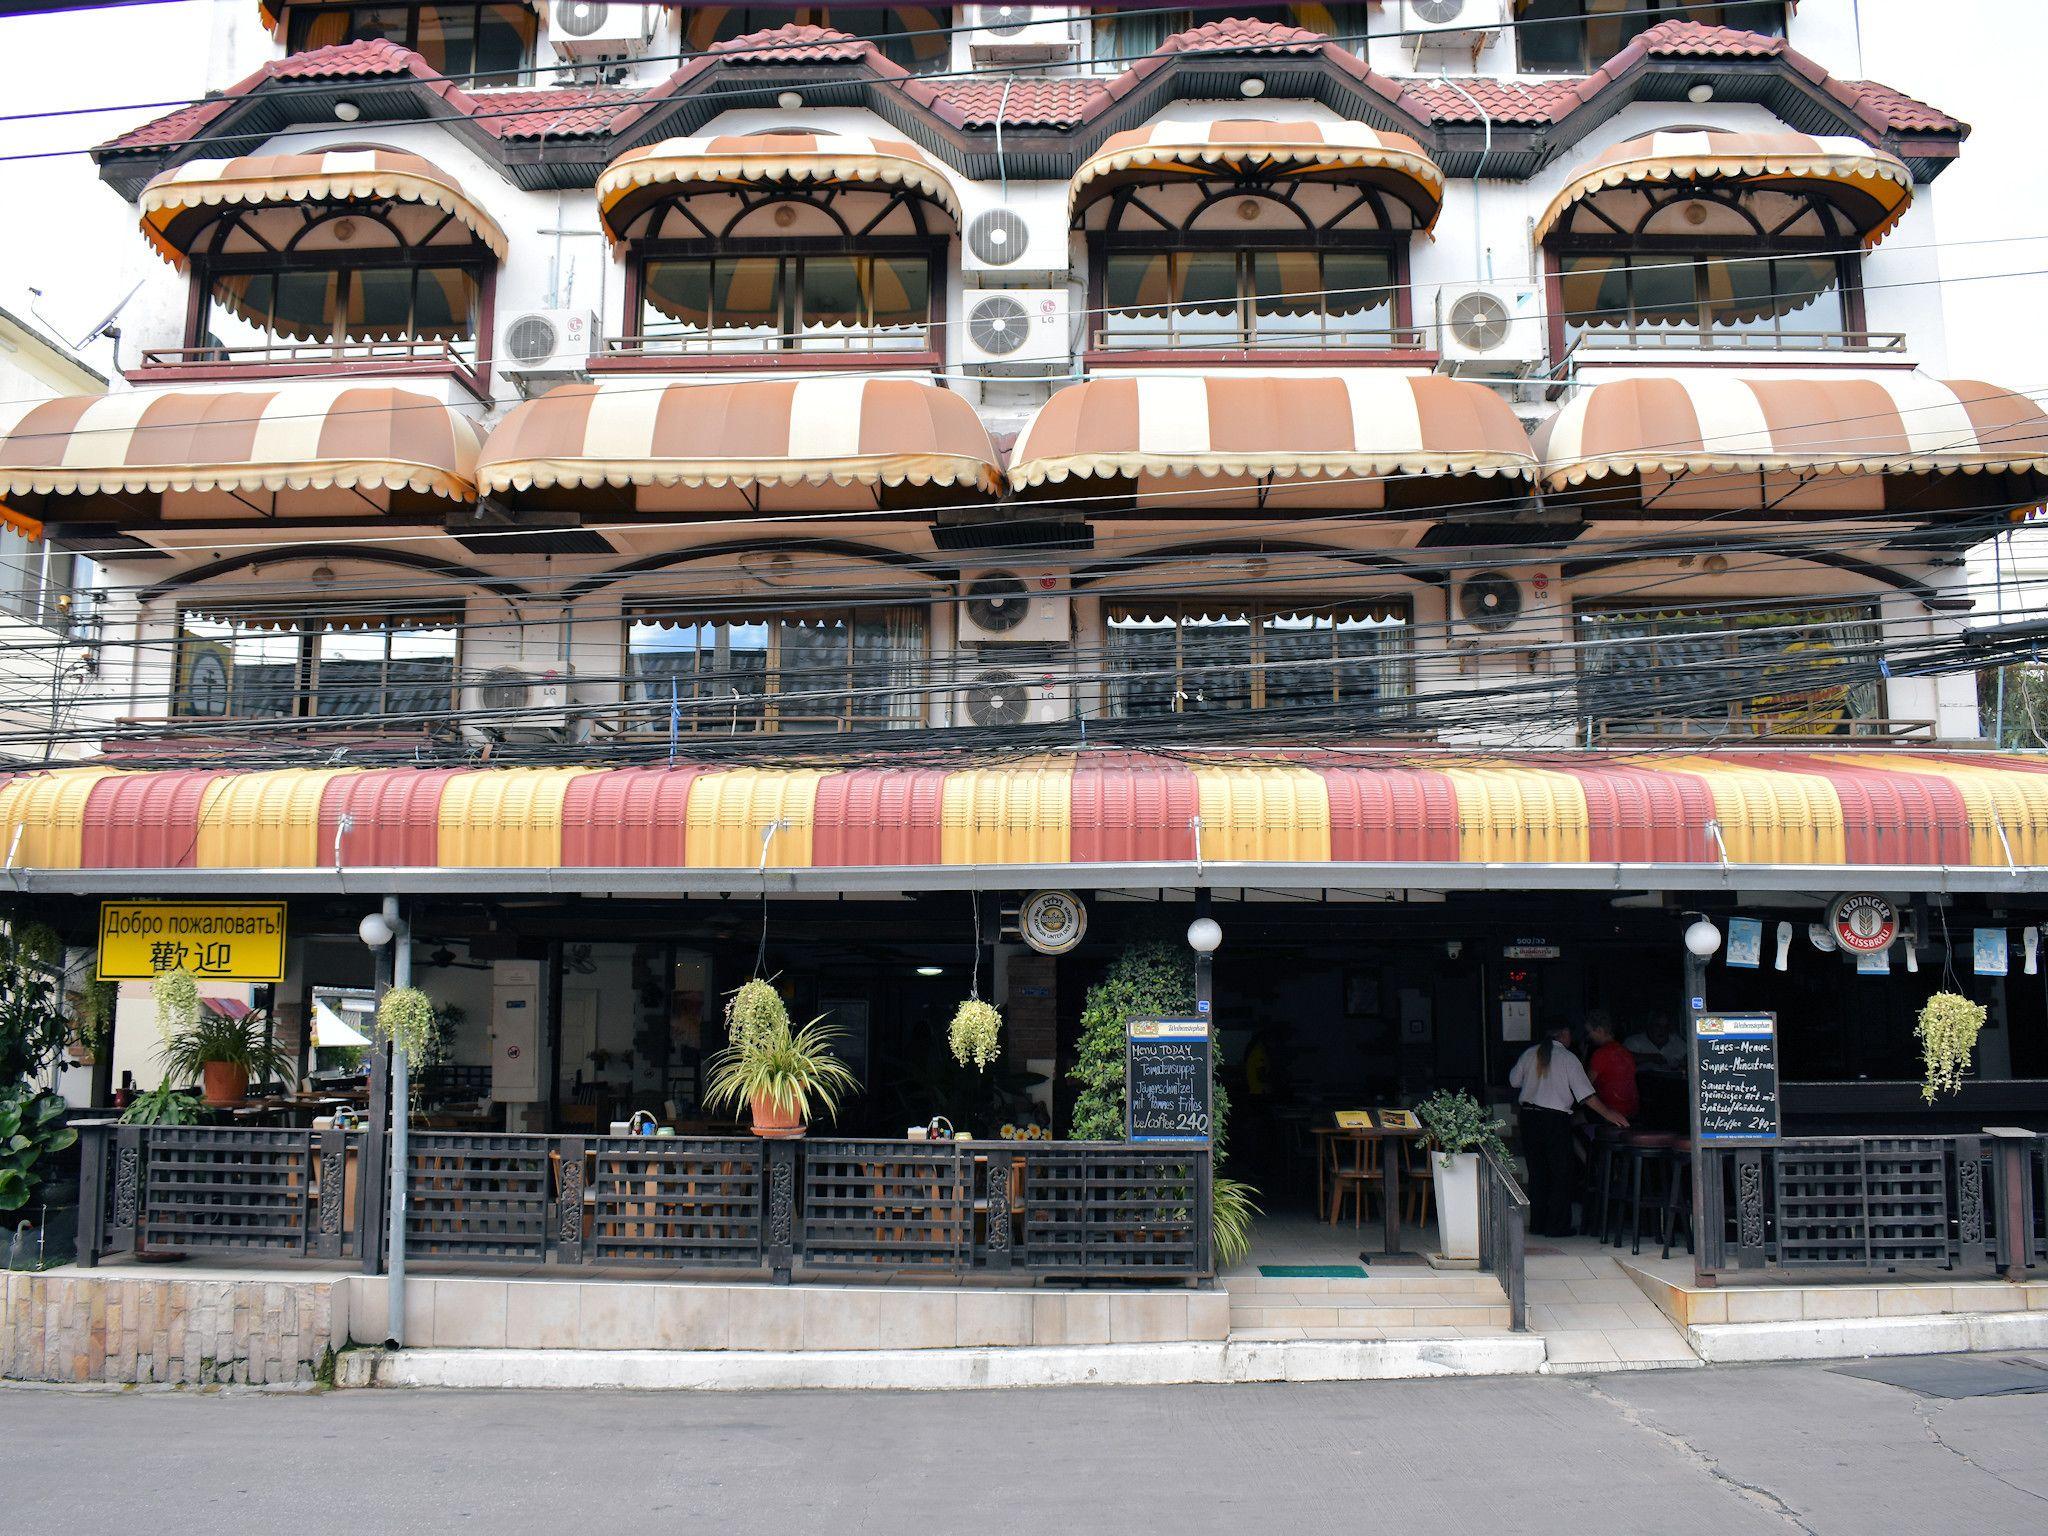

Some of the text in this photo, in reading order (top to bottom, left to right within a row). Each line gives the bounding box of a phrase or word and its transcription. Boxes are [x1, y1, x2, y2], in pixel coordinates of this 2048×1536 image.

[543, 688, 556, 696] LG
[1840, 897, 1890, 918] ERDINGER
[106, 911, 281, 939] Добро пожаловать!
[150, 941, 232, 973] 歡迎
[1159, 1045, 1192, 1056] TODAY
[1140, 1061, 1197, 1080] Tomatensuppe
